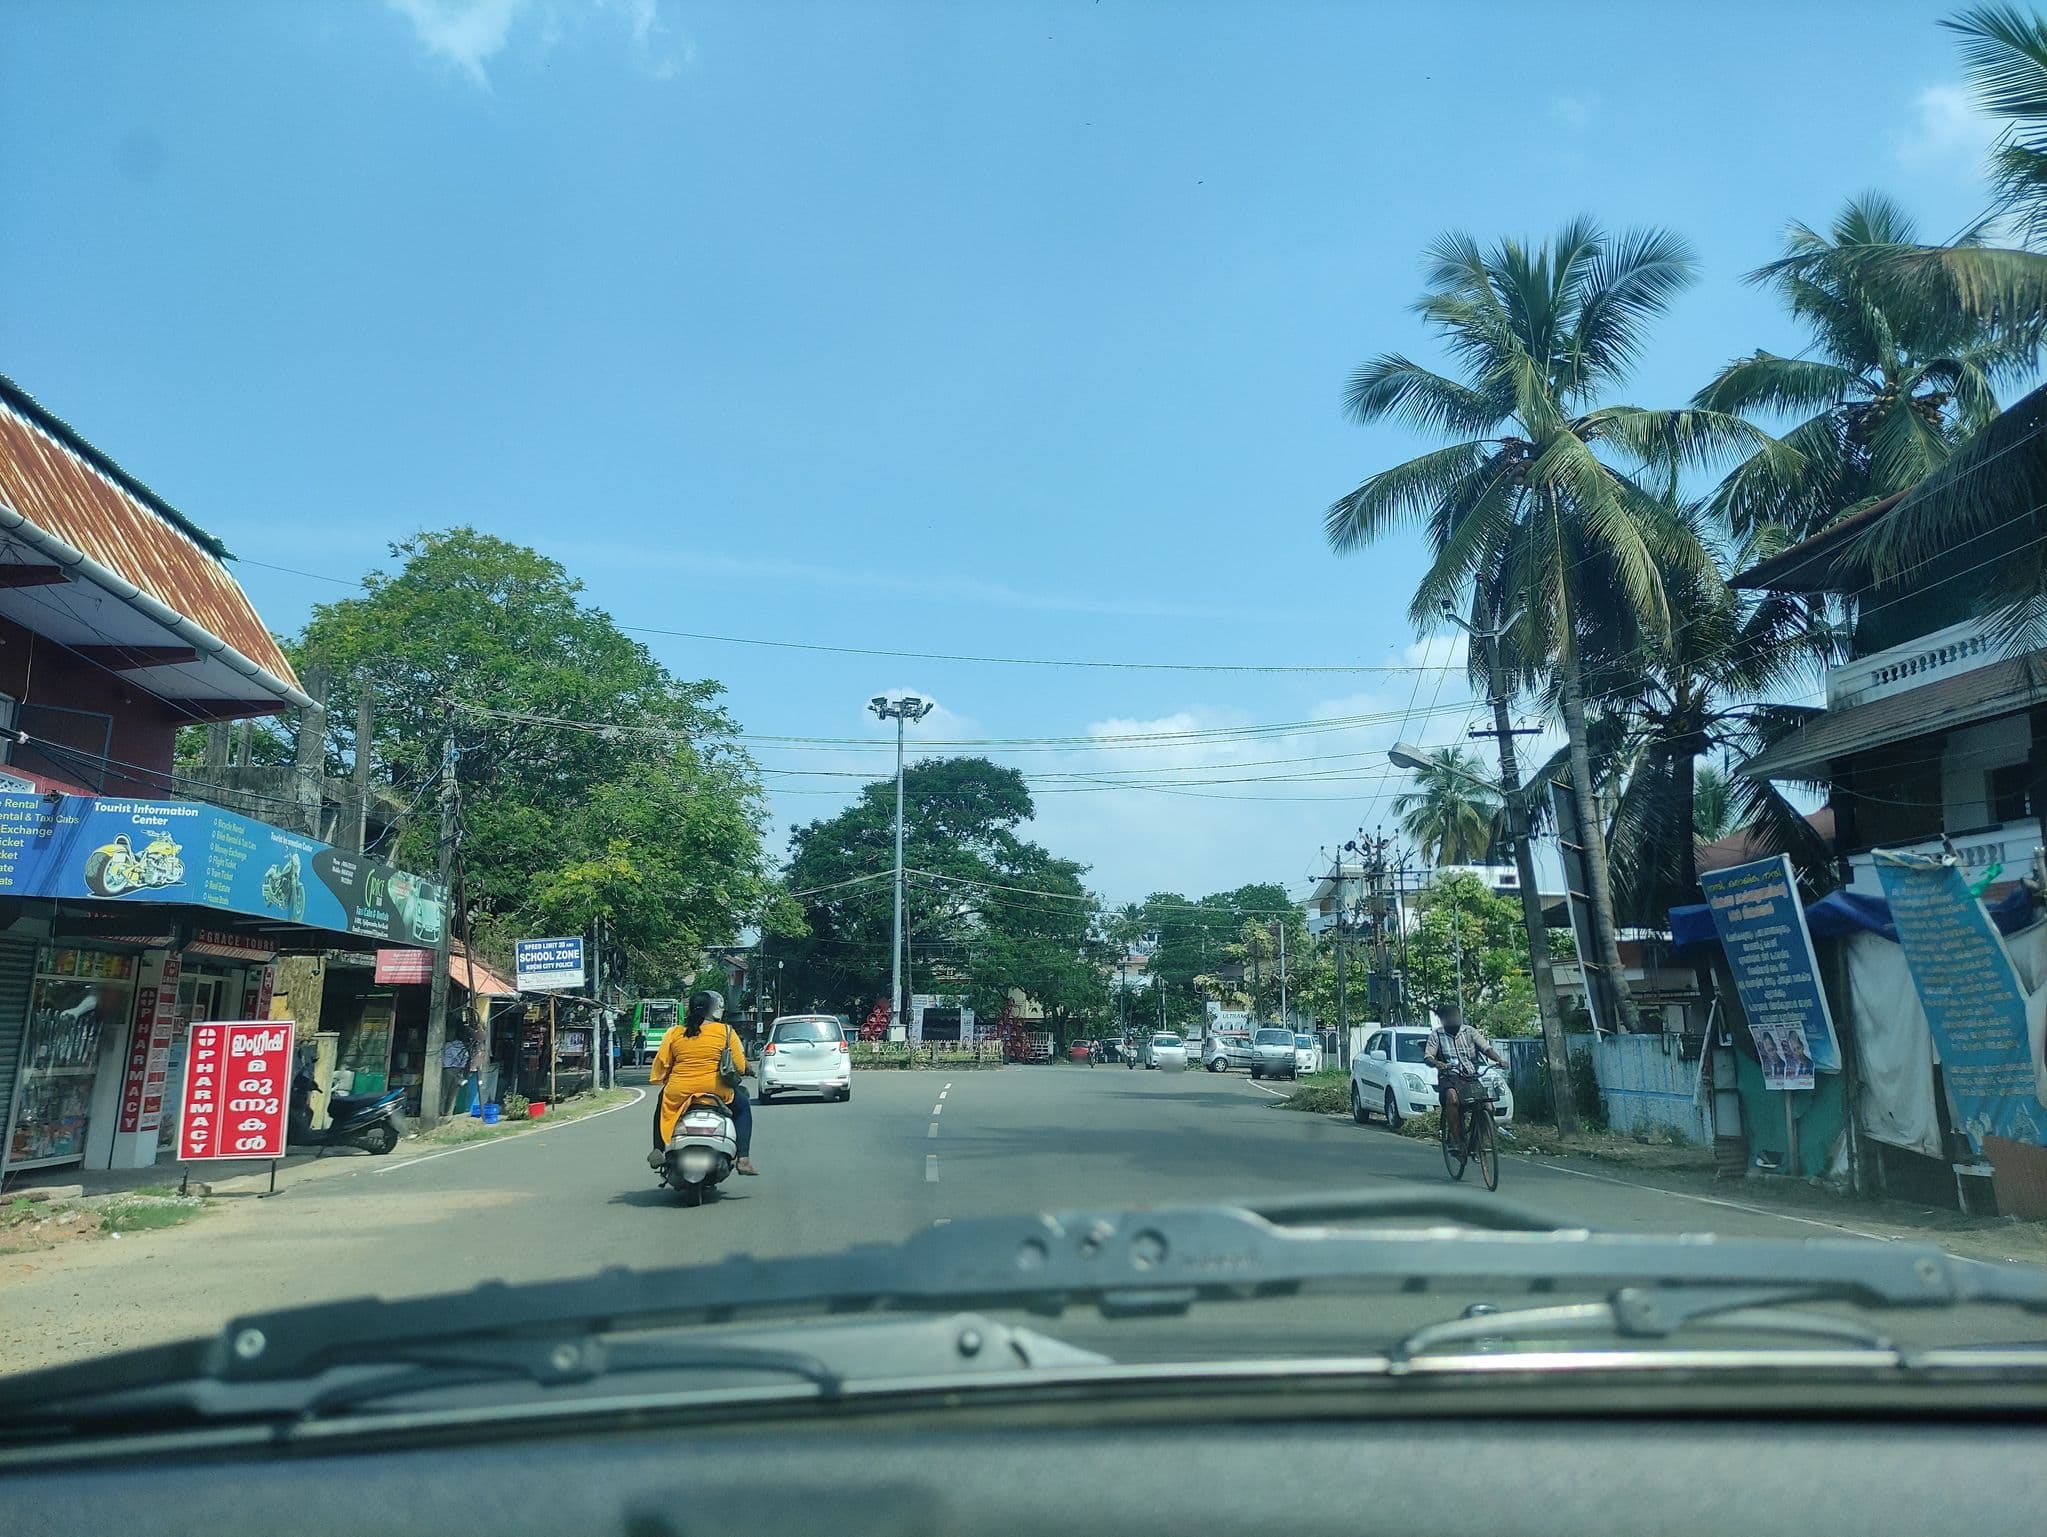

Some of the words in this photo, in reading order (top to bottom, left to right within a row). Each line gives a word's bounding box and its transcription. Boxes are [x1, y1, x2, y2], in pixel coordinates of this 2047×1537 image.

[94, 801, 131, 813] Tourist
[133, 804, 199, 817] Information
[132, 814, 169, 826] Center
[207, 931, 240, 948] GRACE
[245, 935, 275, 951] TOURS
[519, 951, 555, 963] SCHOOL
[556, 949, 580, 960] ZONE
[555, 961, 574, 969] POLICE
[125, 1007, 151, 1129] PHARMACY
[189, 1049, 217, 1154] PHARMACY
